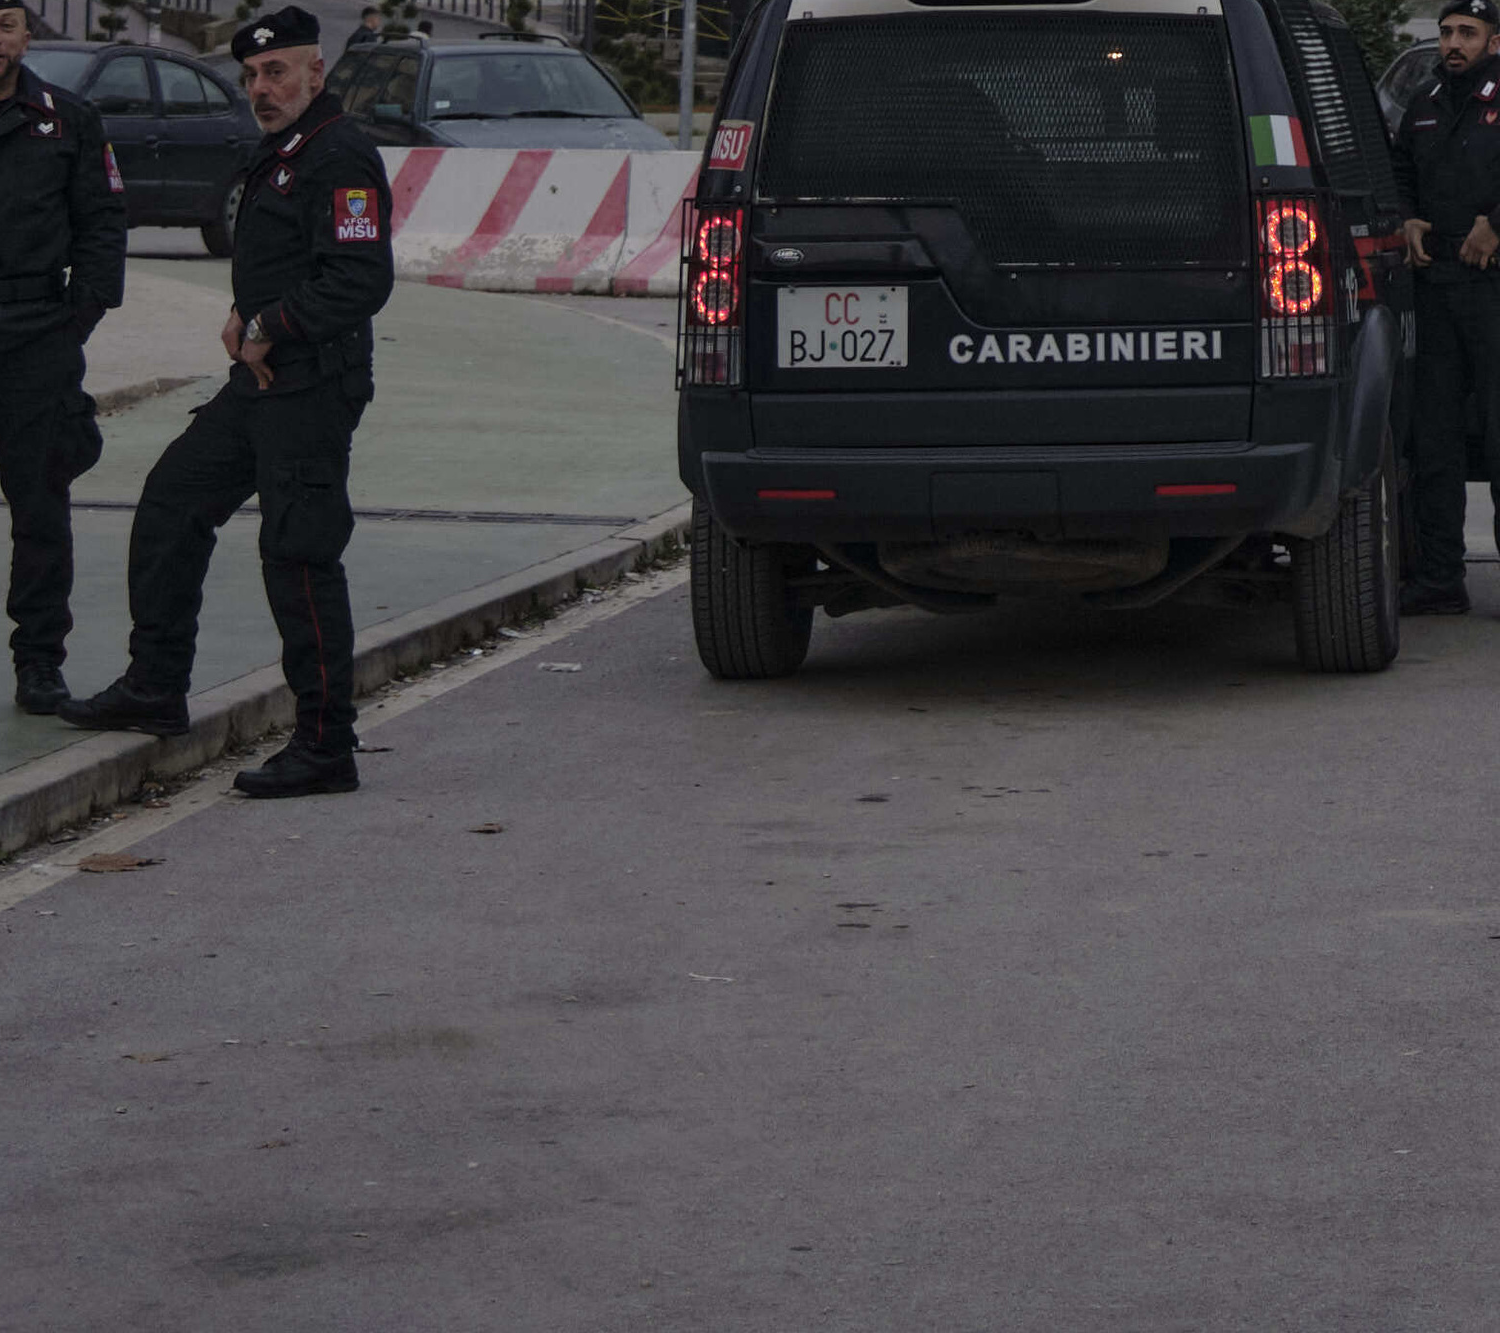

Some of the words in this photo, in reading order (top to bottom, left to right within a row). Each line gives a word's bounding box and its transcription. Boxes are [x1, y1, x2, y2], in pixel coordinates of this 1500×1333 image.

[709, 127, 746, 161] MSU
[337, 223, 378, 240] MSU
[825, 292, 860, 325] CC
[790, 329, 825, 362] BJ
[841, 329, 895, 362] 027
[949, 330, 1222, 364] CARABINIERI
